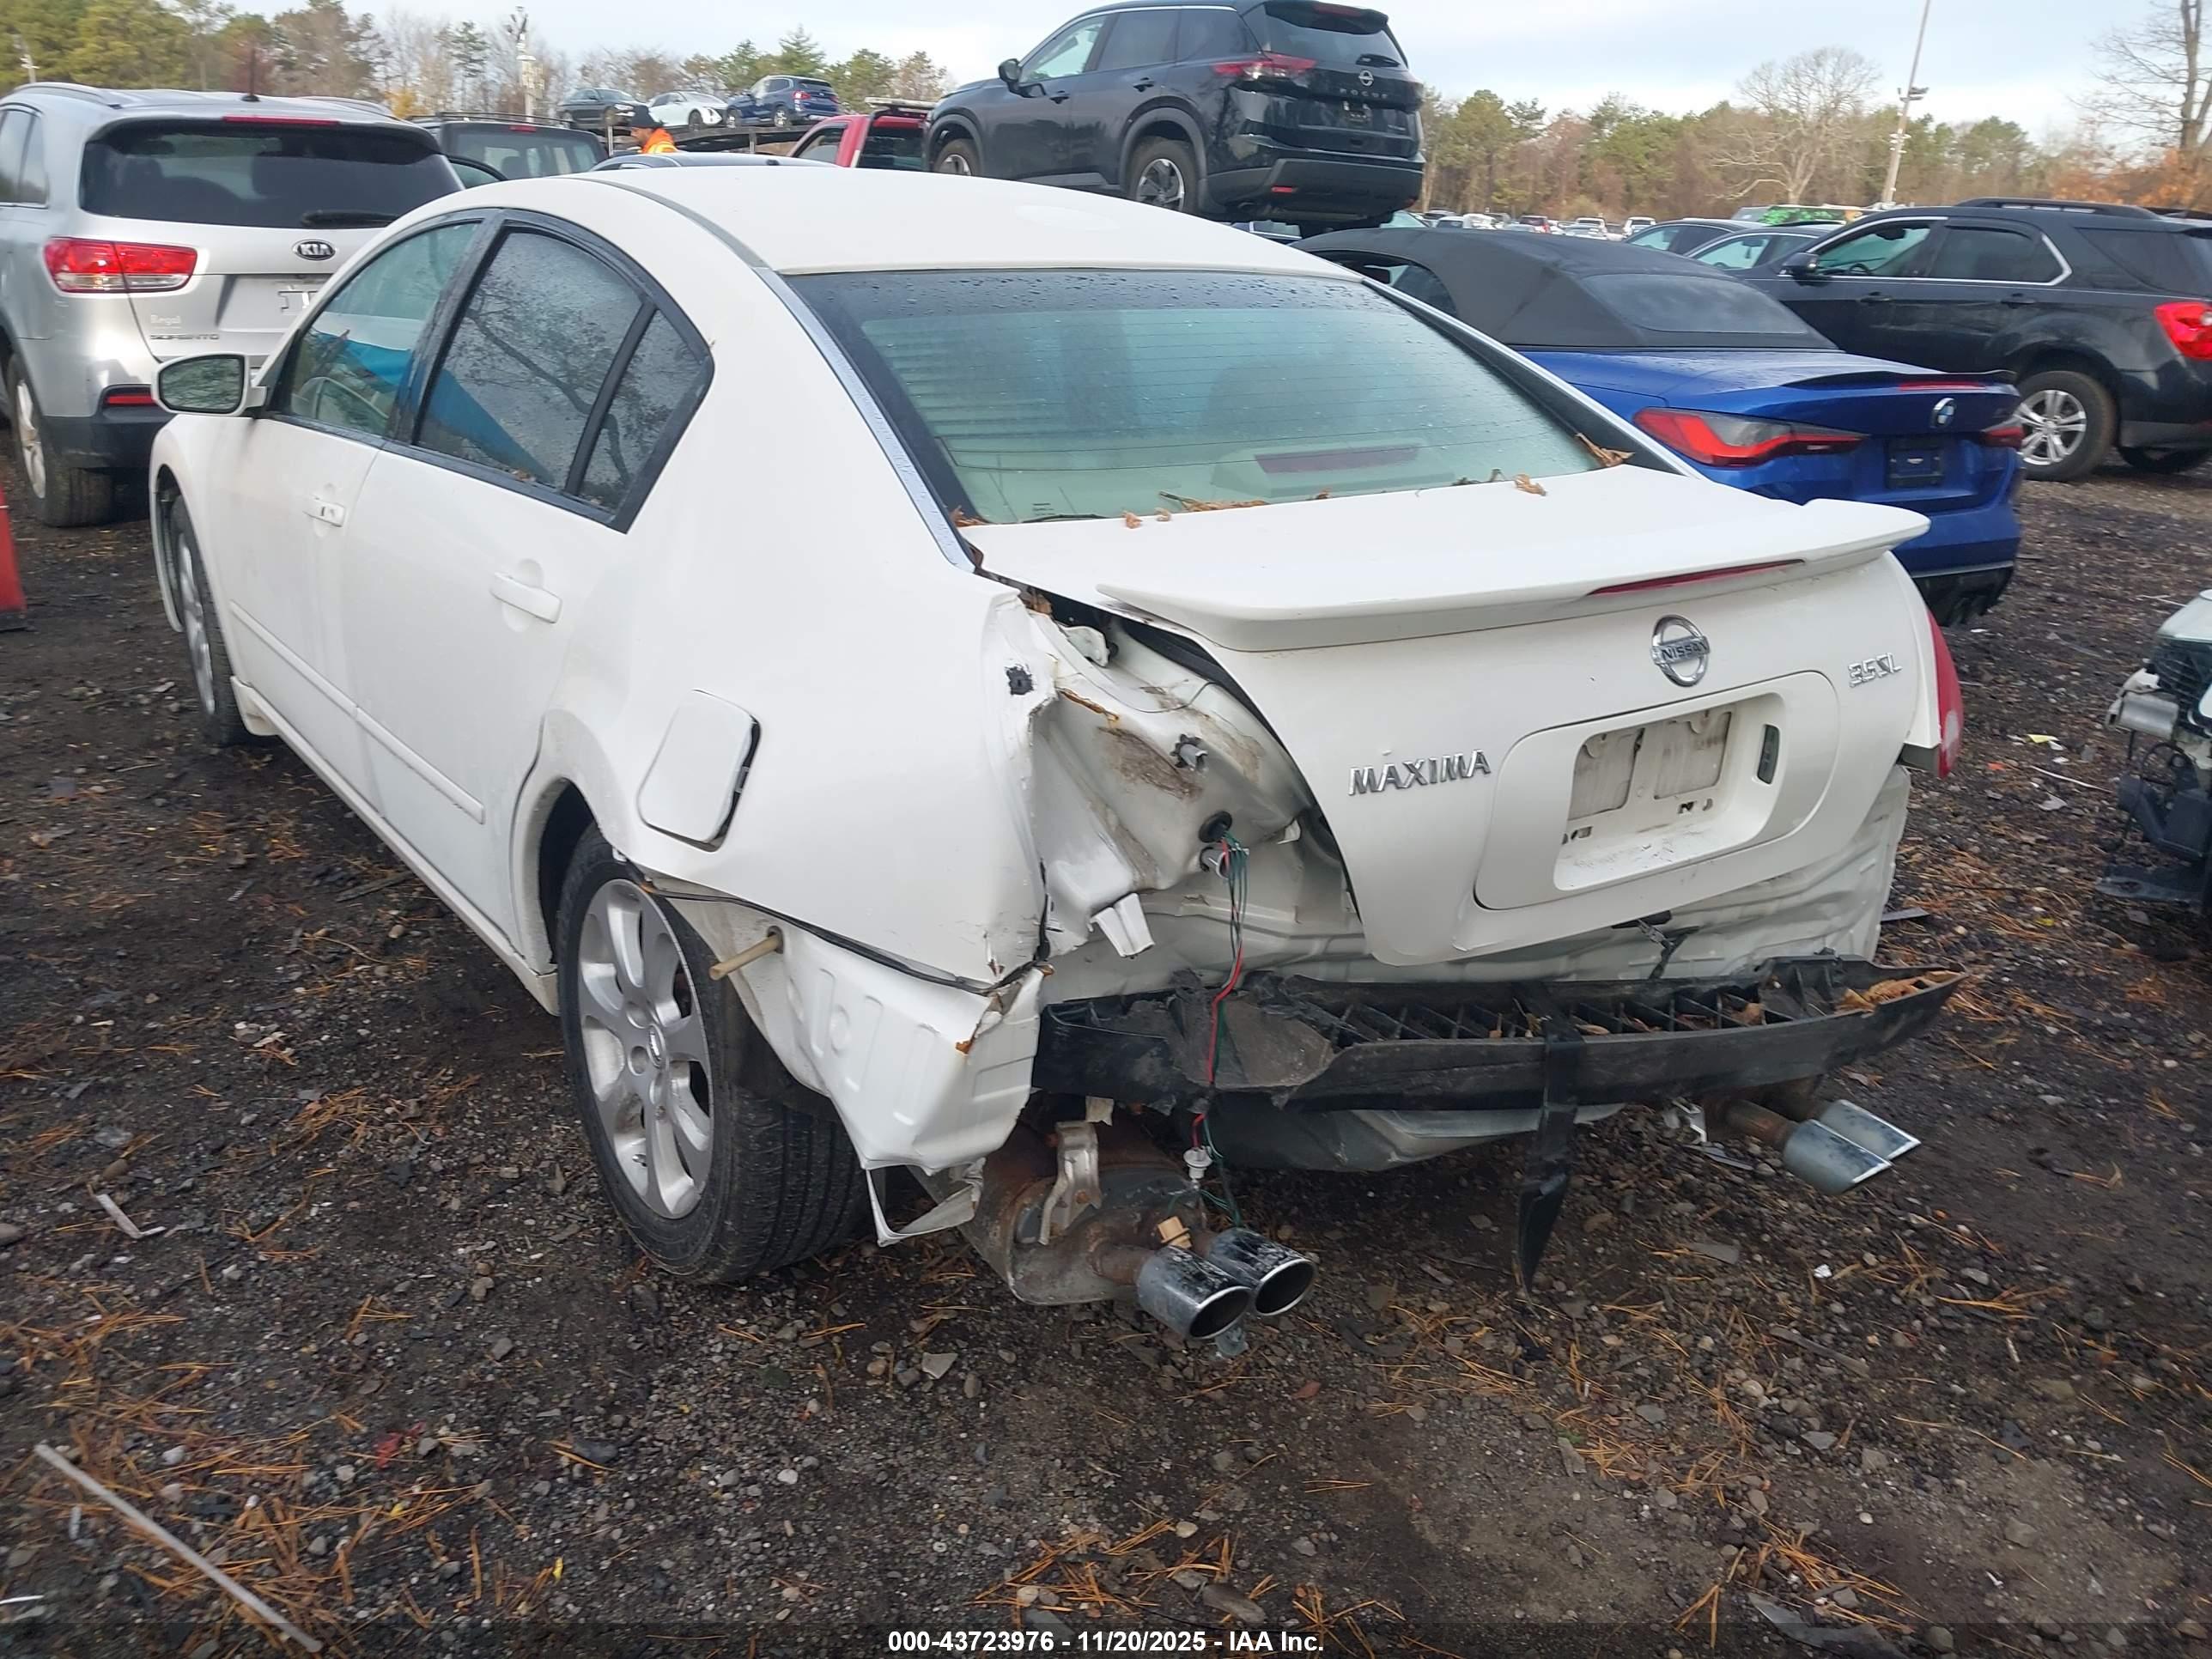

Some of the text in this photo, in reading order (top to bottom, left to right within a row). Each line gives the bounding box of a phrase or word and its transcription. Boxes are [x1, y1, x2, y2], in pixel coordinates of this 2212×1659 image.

[297, 242, 331, 255] KIA
[1660, 639, 1707, 661] NISSAN
[1348, 749, 1492, 796] MAXIMA
